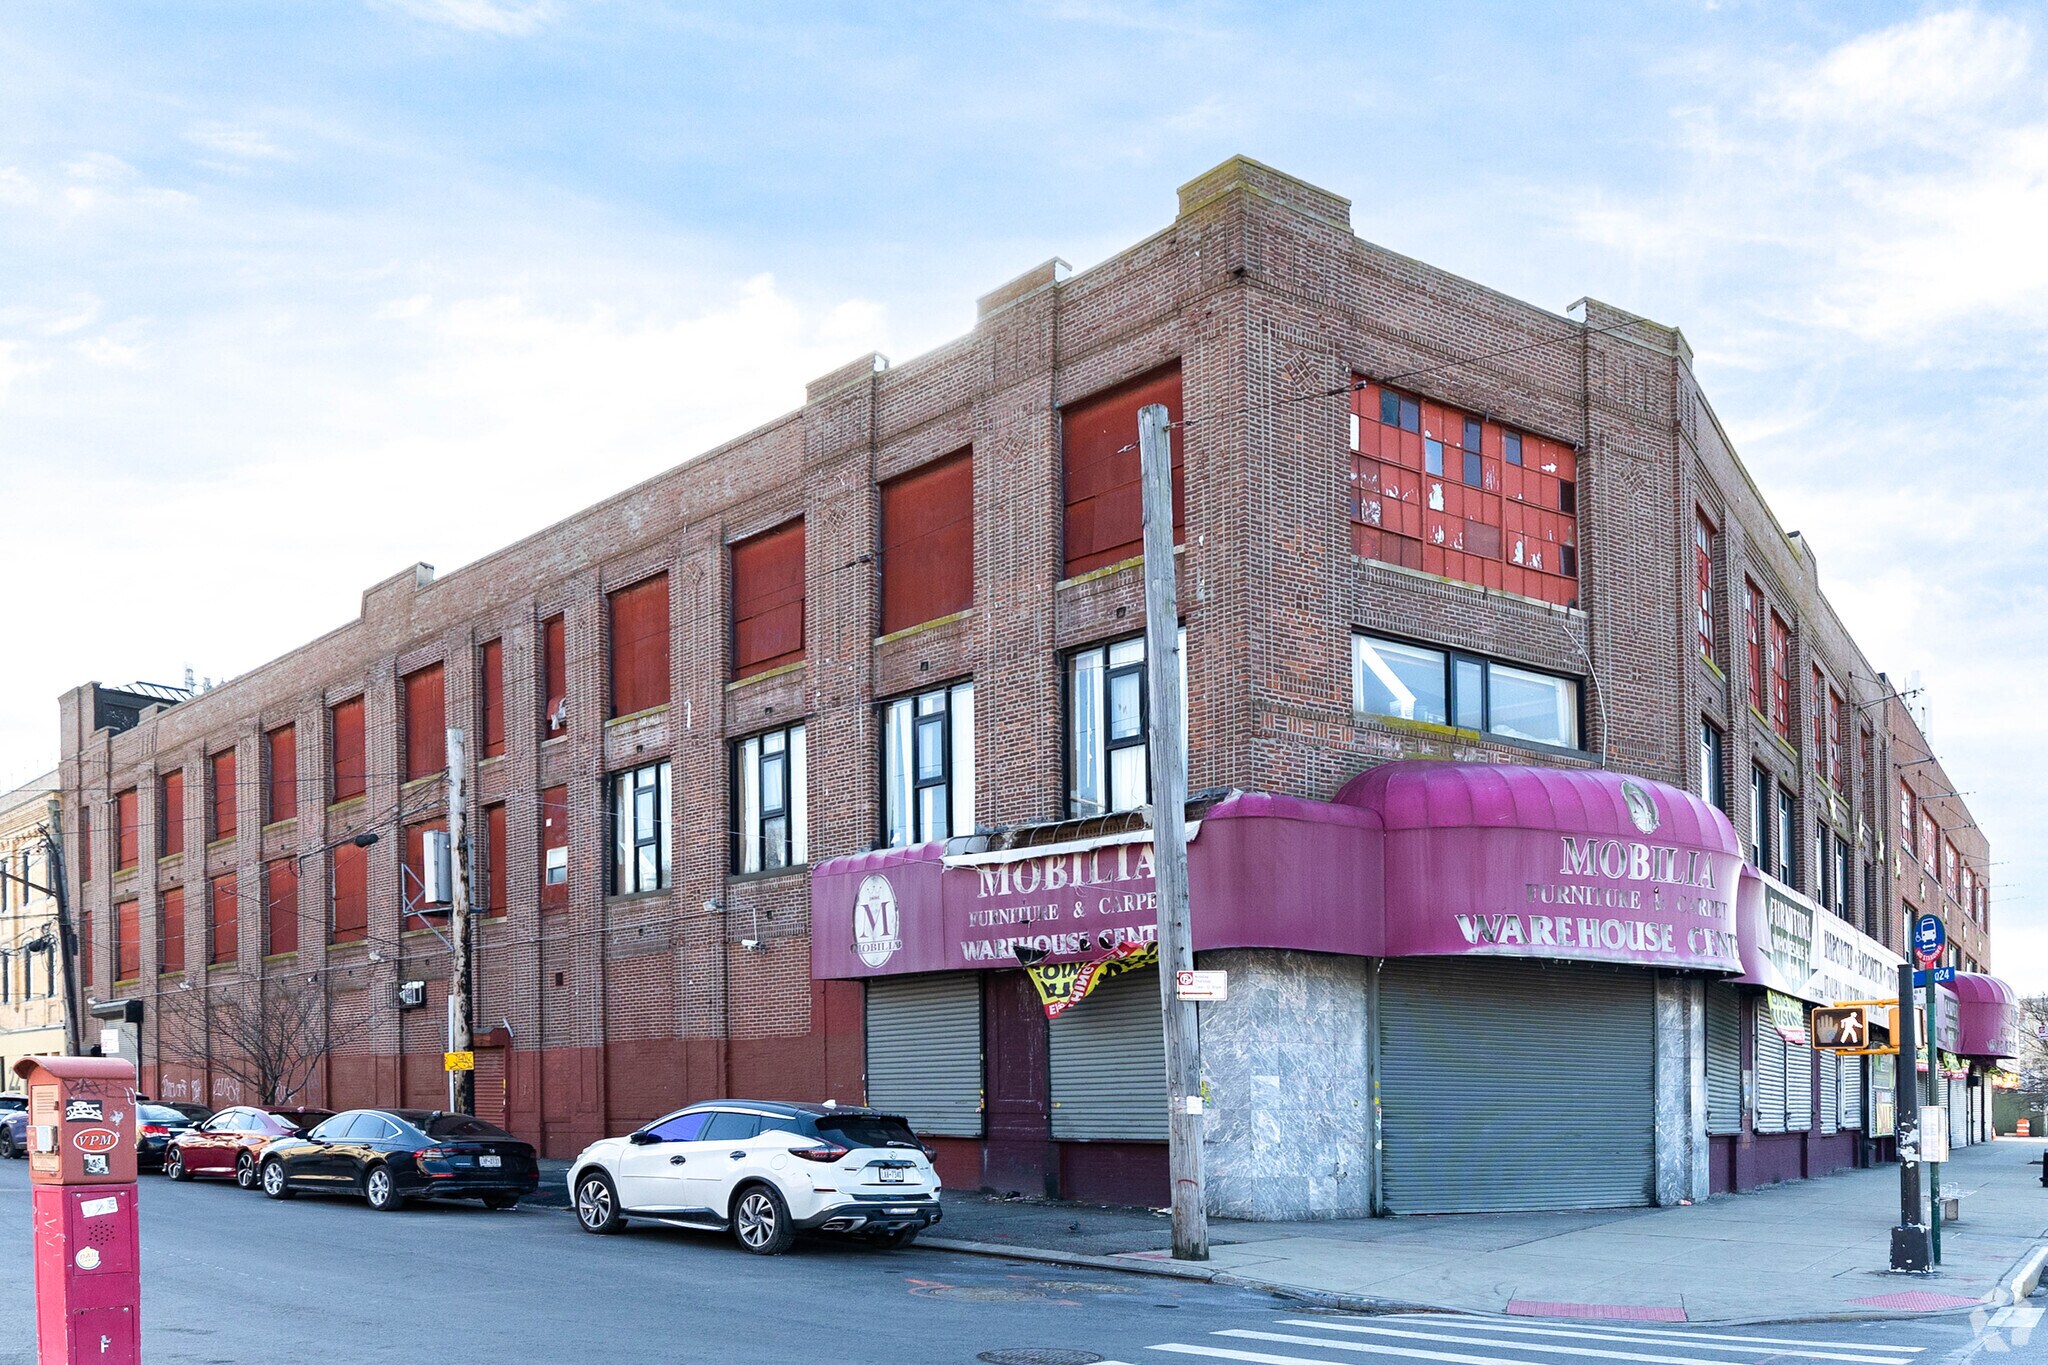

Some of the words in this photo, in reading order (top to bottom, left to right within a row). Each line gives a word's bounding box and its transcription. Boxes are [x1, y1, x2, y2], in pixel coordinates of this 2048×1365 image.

[976, 843, 1156, 898] MOBILIA
[1560, 836, 1716, 890] MOBILIA
[859, 901, 892, 938] M
[968, 904, 1060, 928] FURNITURE
[1073, 901, 1086, 918] &
[1526, 883, 1641, 910] FURNITURE
[1677, 894, 1728, 920] CARPET
[960, 932, 1092, 961] WAREHOUSE
[1454, 914, 1677, 954] WAREHOUSE
[79, 1134, 112, 1147] VPM
